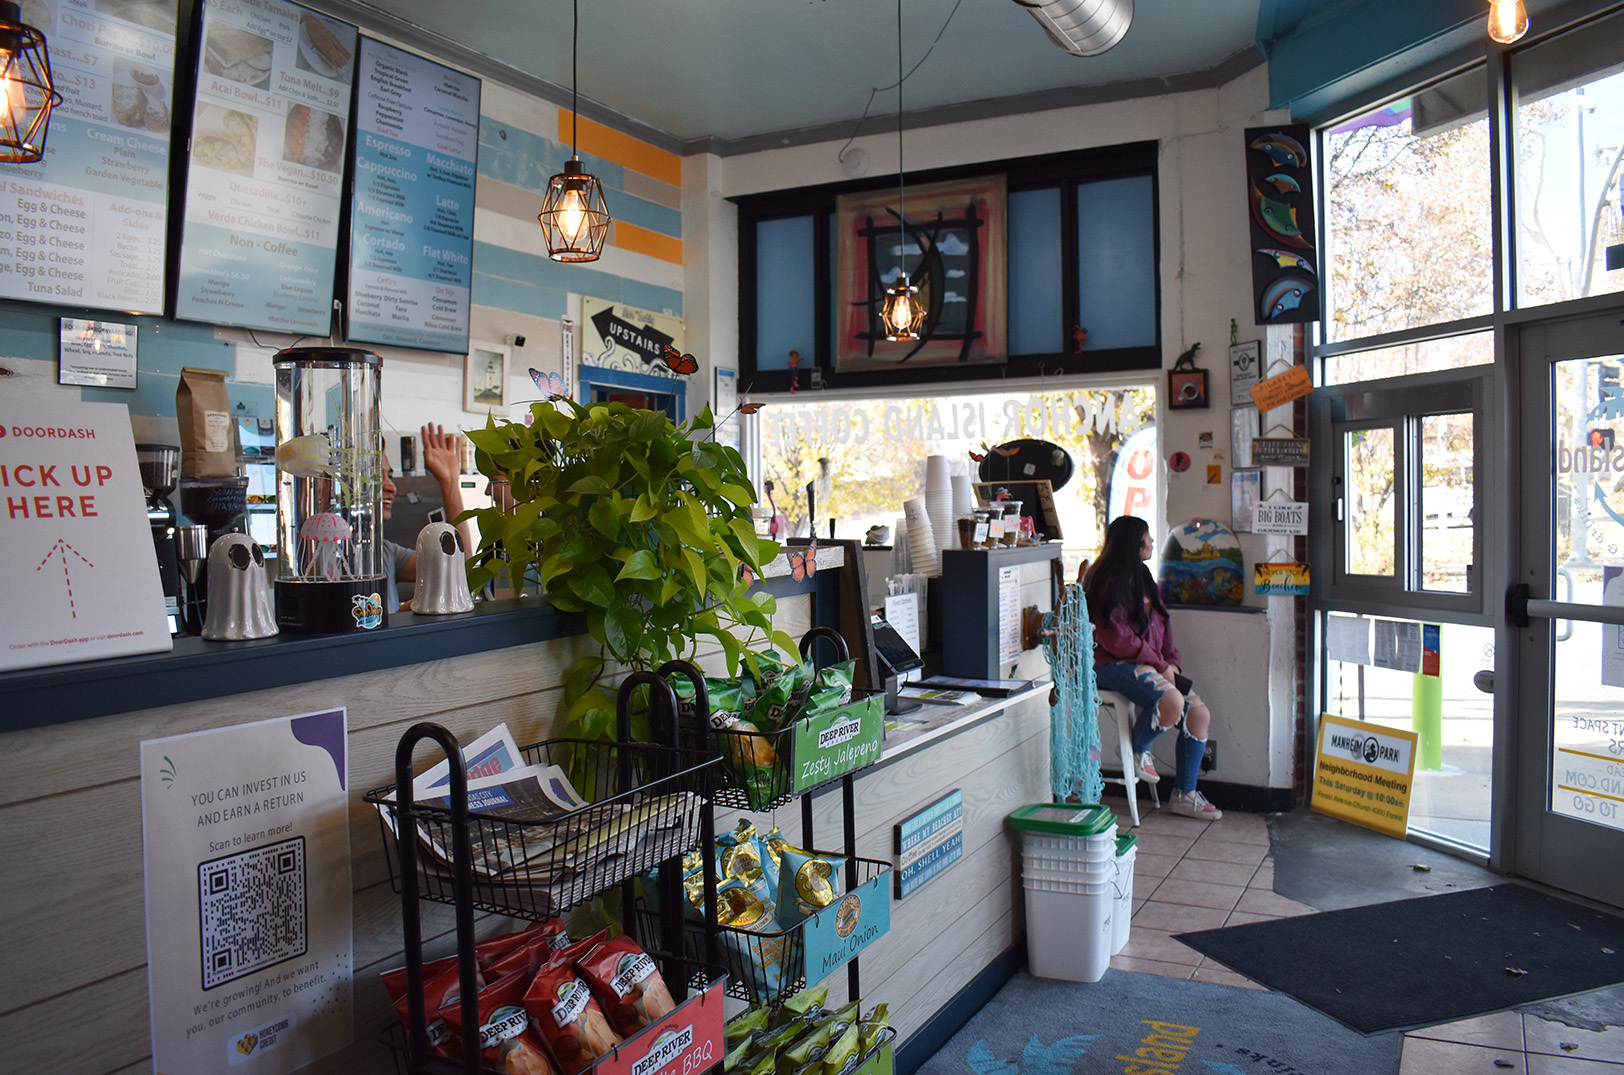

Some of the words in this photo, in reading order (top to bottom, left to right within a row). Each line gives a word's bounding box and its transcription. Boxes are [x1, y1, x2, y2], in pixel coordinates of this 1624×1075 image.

[211, 81, 232, 95] Acai
[280, 71, 301, 86] Tuna
[87, 128, 124, 145] Cream
[127, 138, 167, 156] Cheese
[114, 147, 136, 159] Plain
[365, 135, 411, 157] Espresso
[102, 156, 150, 174] Strawberry
[258, 157, 275, 170] The
[357, 156, 417, 182] Cappuccino
[426, 153, 473, 176] Macchiato
[85, 166, 118, 180] Garden
[120, 173, 163, 190] Vegetable
[10, 183, 84, 206] Sandwiches
[436, 195, 459, 210] Latte
[17, 198, 38, 212] Egg
[40, 204, 47, 212] &
[50, 204, 86, 219] Cheese
[110, 203, 153, 218] Add-ons
[357, 202, 413, 224] Americano
[16, 214, 37, 228] Egg
[39, 220, 47, 228] &
[49, 219, 85, 235] Cheese
[122, 218, 149, 231] Sides
[208, 209, 237, 224] Verde
[238, 215, 275, 231] Chicken
[16, 231, 36, 245] Egg
[39, 236, 47, 245] &
[49, 236, 85, 250] Cheese
[229, 234, 254, 248] Non
[263, 240, 299, 256] Coffee
[363, 233, 406, 252] Cortado
[15, 247, 36, 262] Egg
[38, 252, 46, 261] &
[48, 252, 84, 266] Cheese
[423, 245, 441, 258] Flat
[442, 248, 469, 265] White
[15, 263, 35, 277] Egg
[38, 267, 46, 276] &
[48, 267, 84, 281] Cheese
[27, 282, 53, 294] Tuna
[55, 285, 83, 297] Salad
[609, 321, 661, 356] UPSTAIRS
[12, 426, 96, 440] DOORDASH
[0, 464, 61, 487] ICK
[71, 465, 113, 487] UP
[1123, 449, 1154, 516] OP
[7, 495, 99, 519] HERE
[1258, 510, 1272, 523] BIG
[1274, 510, 1302, 524] BOATS
[50, 637, 78, 646] DoorDash
[107, 631, 143, 639] doordash.com
[820, 730, 839, 744] DEEP
[838, 722, 859, 737] RIVER
[1331, 734, 1363, 754] MANHEIM
[1380, 746, 1400, 763] PARK
[801, 756, 831, 780] Zesty
[1319, 761, 1373, 783] Neighborhood
[1375, 775, 1408, 795] Meeting
[191, 792, 214, 807] YOU
[217, 786, 239, 801] CAN
[242, 777, 278, 795] INVEST
[280, 774, 291, 787] IN
[293, 771, 307, 784] US
[1319, 776, 1333, 787] This
[1334, 781, 1366, 798] Saturday
[197, 811, 221, 827] AND
[223, 804, 251, 821] EARN
[254, 801, 261, 814] A
[263, 792, 305, 811] RETURN
[209, 835, 230, 852] Scan
[233, 836, 242, 846] to
[244, 828, 265, 844] learn
[268, 822, 293, 839] more!
[918, 850, 940, 870] SHELL
[822, 940, 846, 973] Maui
[850, 925, 878, 952] Onion
[193, 998, 220, 1016] We're
[223, 982, 263, 1006] growing!
[264, 974, 281, 989] And
[283, 969, 296, 981] we
[297, 961, 319, 976] want
[615, 967, 635, 993] DEEP
[185, 1022, 207, 1039] you,
[208, 1016, 225, 1028] our
[227, 993, 281, 1021] community,
[282, 987, 292, 998] to
[293, 975, 327, 993] benefit.
[555, 1000, 576, 1021] DEEP
[259, 1019, 289, 1039] HONEYCOMB
[259, 1035, 278, 1050] CREDIT
[634, 1051, 661, 1075] DEEP
[661, 1030, 691, 1058] RIVER
[682, 1040, 713, 1075] BBQ
